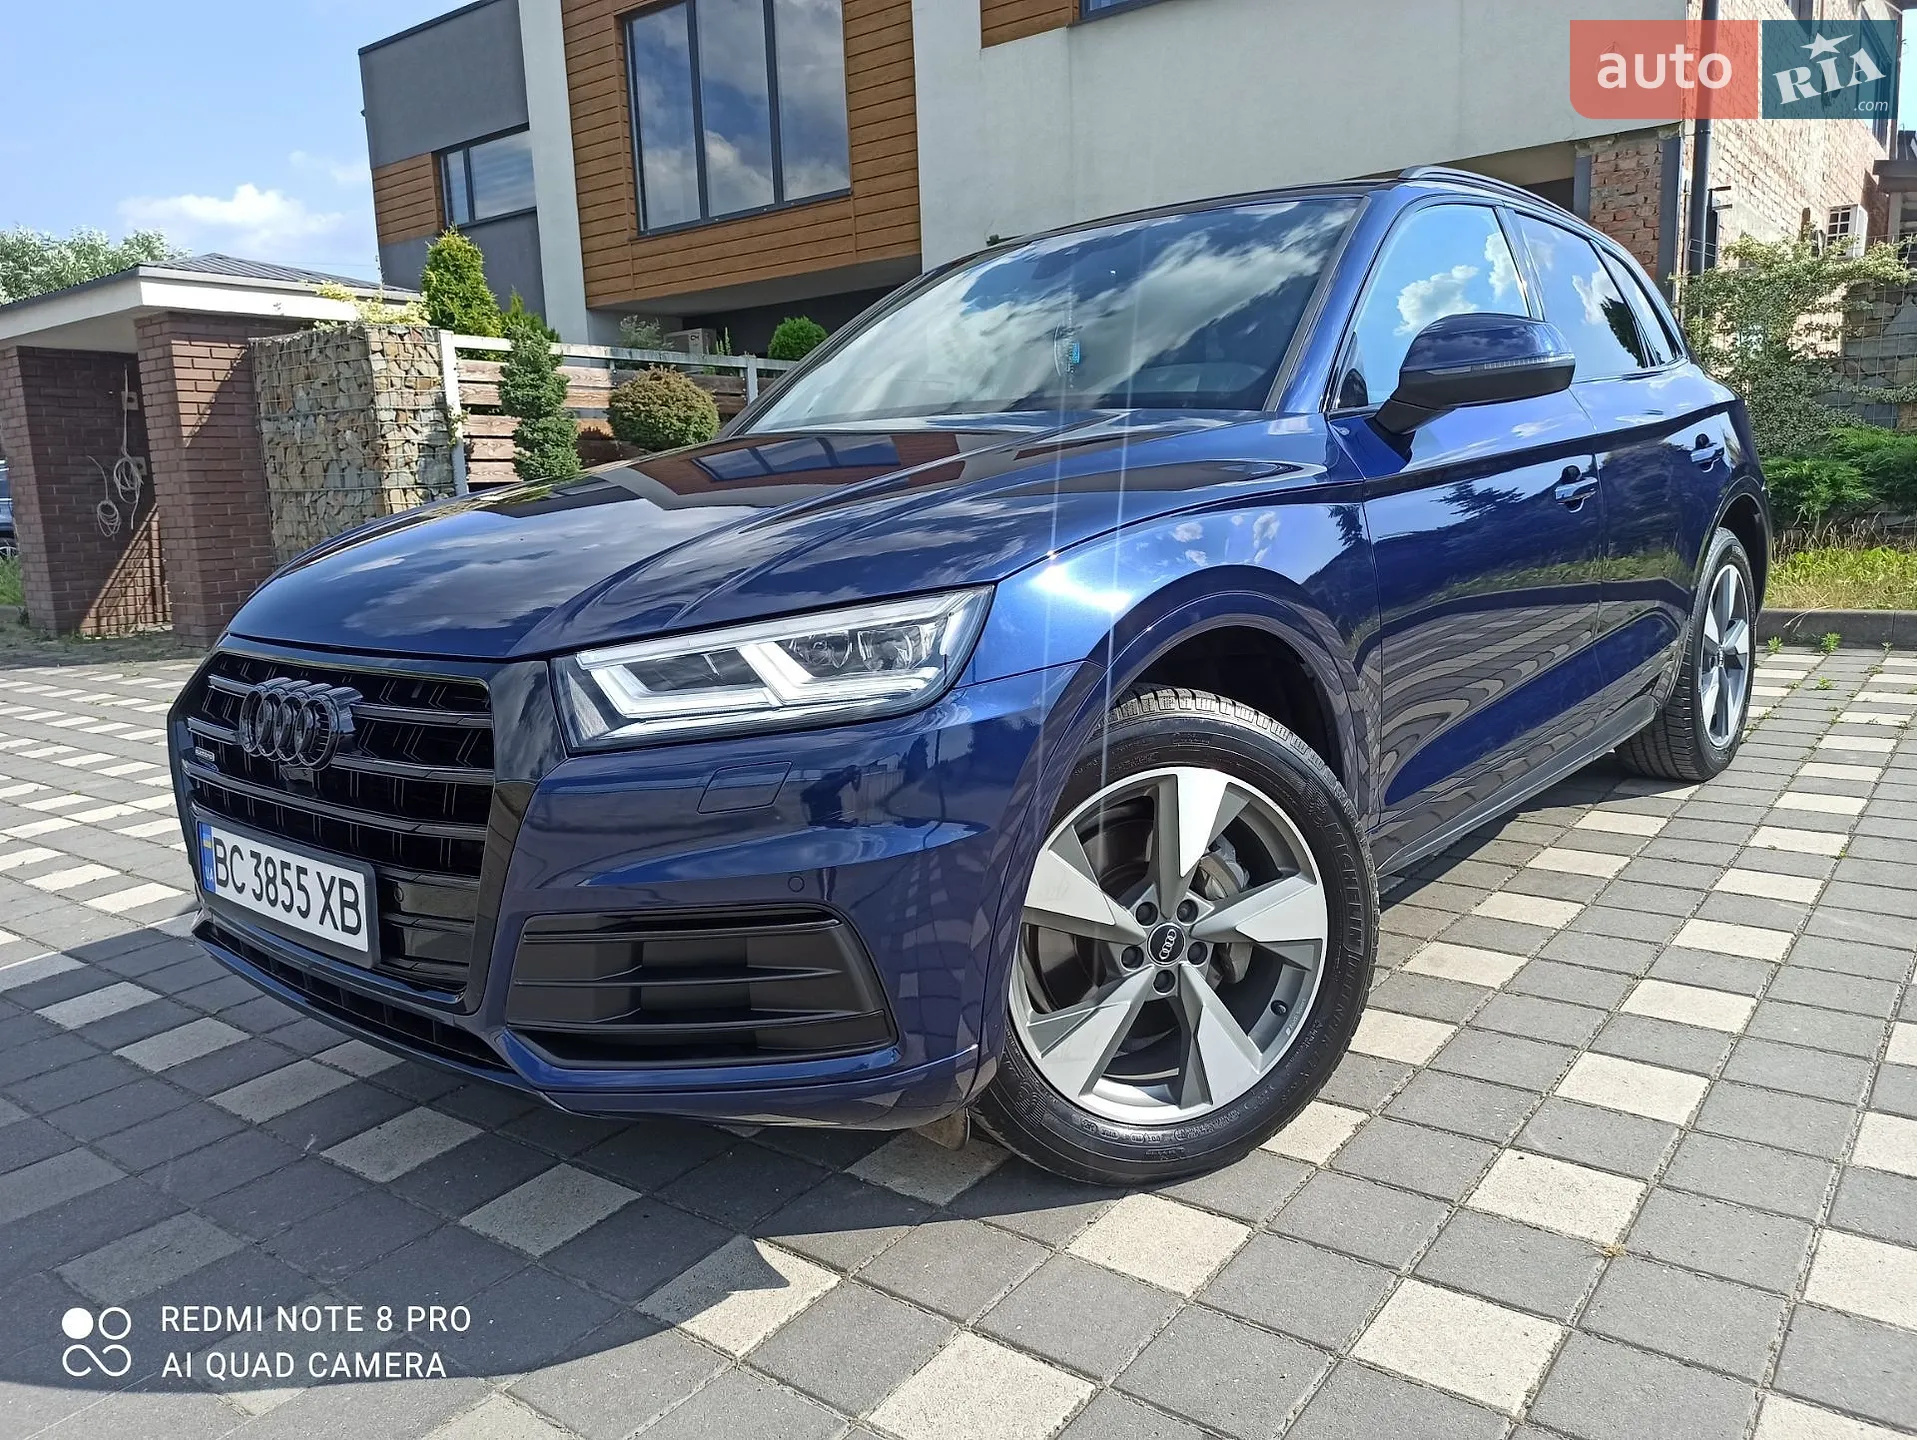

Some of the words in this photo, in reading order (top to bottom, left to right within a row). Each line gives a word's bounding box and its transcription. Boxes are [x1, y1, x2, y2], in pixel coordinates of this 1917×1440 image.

[213, 836, 246, 894] BC
[249, 849, 311, 919] 3855
[316, 871, 362, 936] XB
[1325, 823, 1364, 949] MICHELIN
